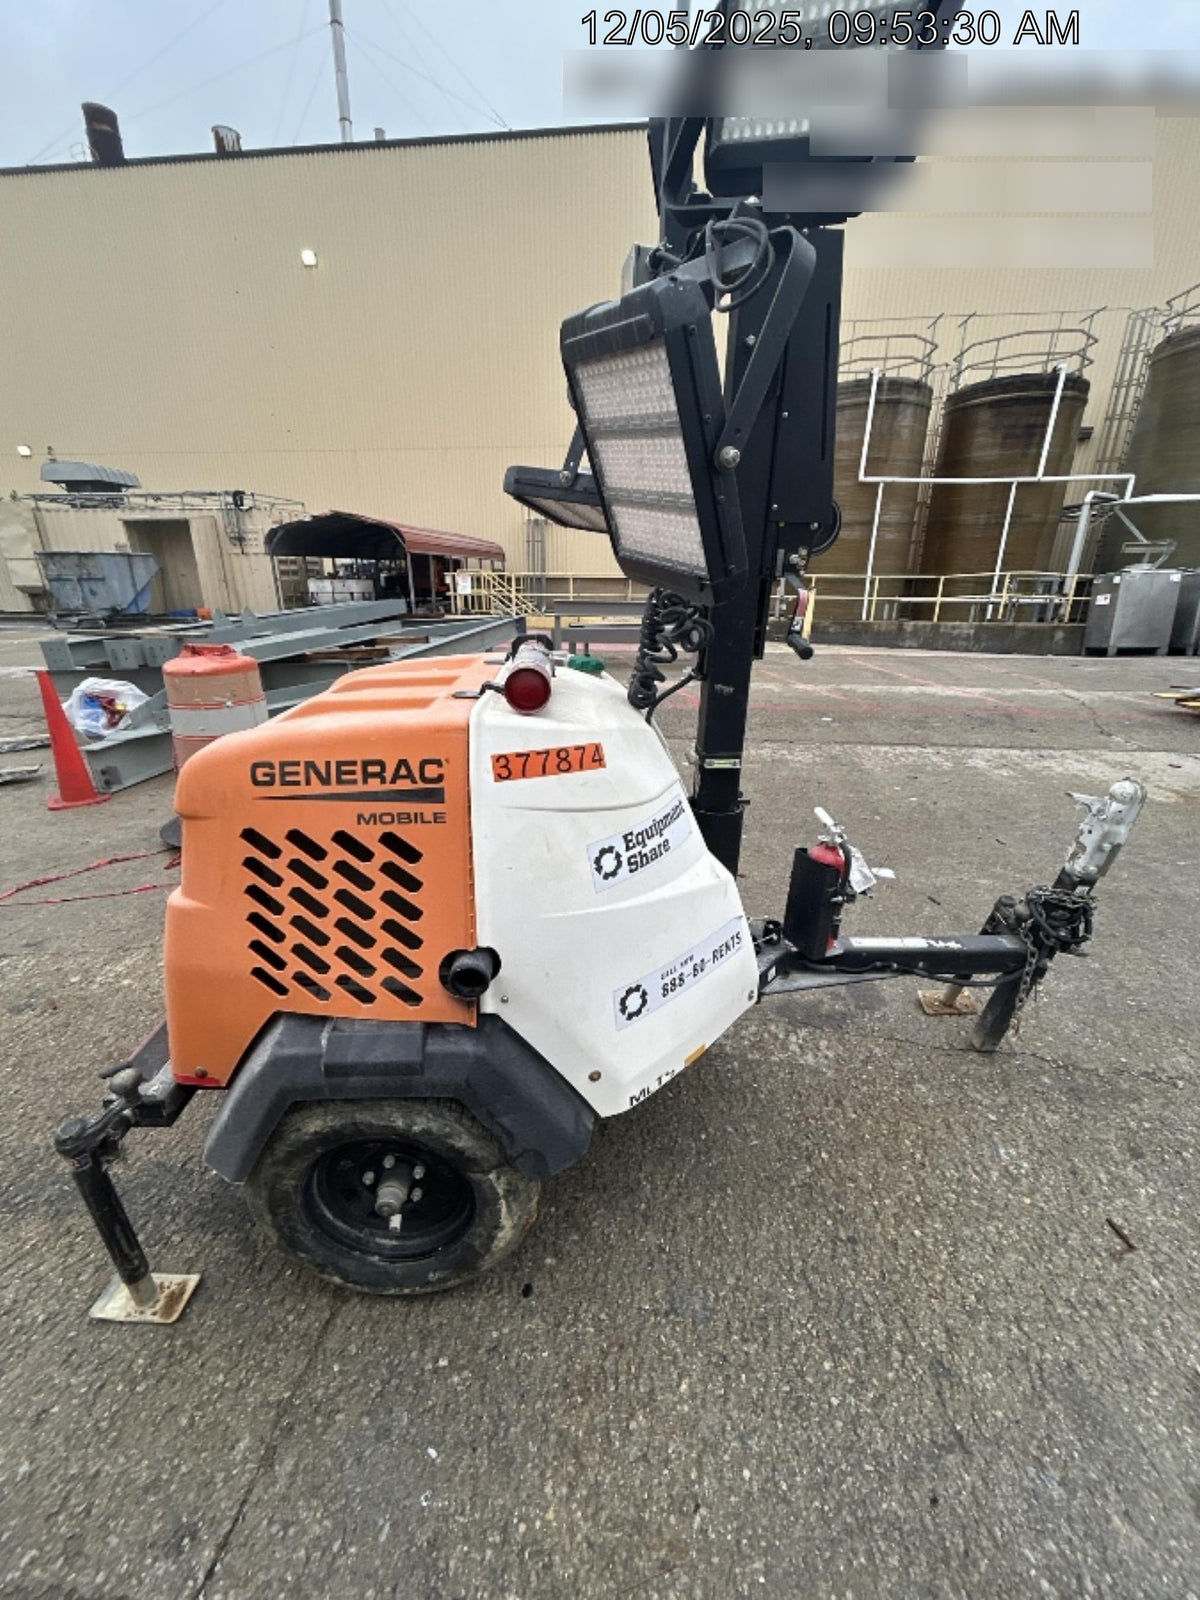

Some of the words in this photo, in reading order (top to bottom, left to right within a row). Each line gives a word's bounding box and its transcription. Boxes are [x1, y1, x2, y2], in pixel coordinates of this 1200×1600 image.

[250, 758, 445, 787] GENERAC
[495, 745, 604, 780] 377874
[356, 811, 447, 825] MOBILE
[622, 800, 685, 852] Equipment
[627, 838, 671, 873] Share
